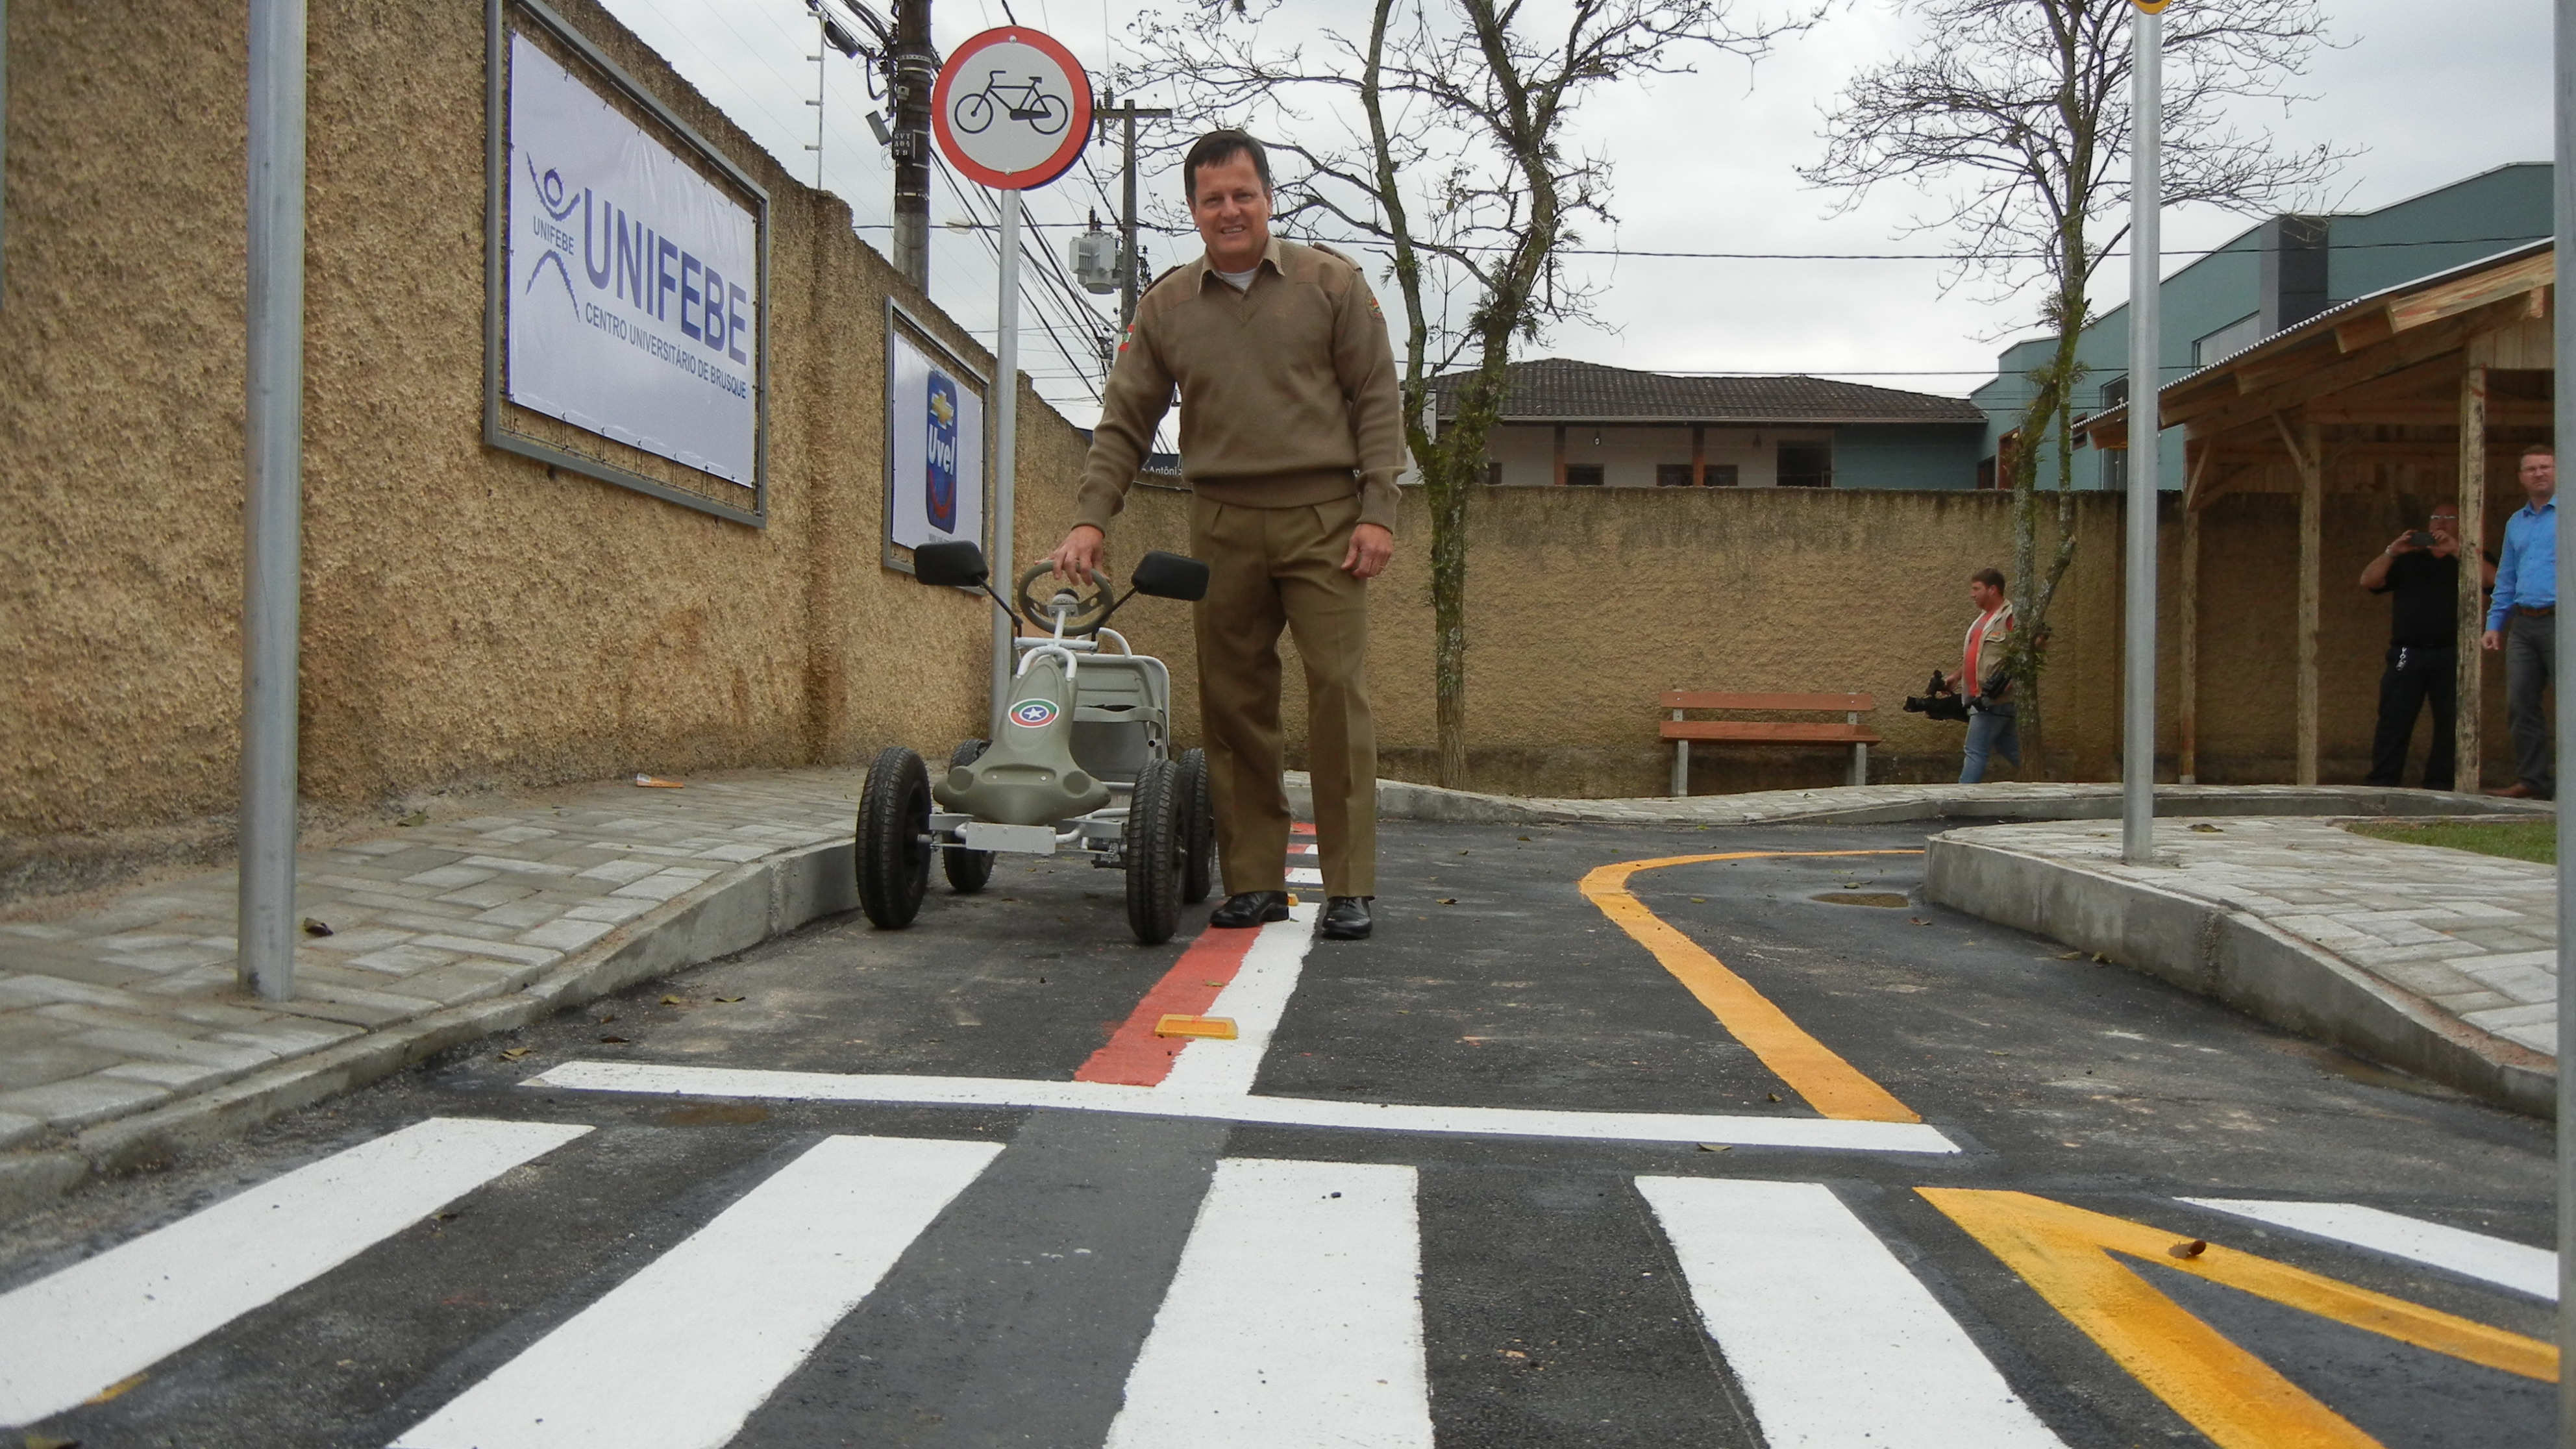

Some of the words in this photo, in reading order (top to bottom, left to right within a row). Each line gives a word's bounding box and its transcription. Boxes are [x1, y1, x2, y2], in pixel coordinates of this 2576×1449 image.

[534, 215, 574, 256] UNIFEBE
[585, 187, 747, 366] UNIFEBE
[586, 301, 627, 341] CENTRO
[629, 324, 696, 375] UNIVERSITÁRIO
[698, 358, 708, 381] DE
[711, 367, 746, 399] BRUSQUE
[928, 423, 956, 475] Uvel
